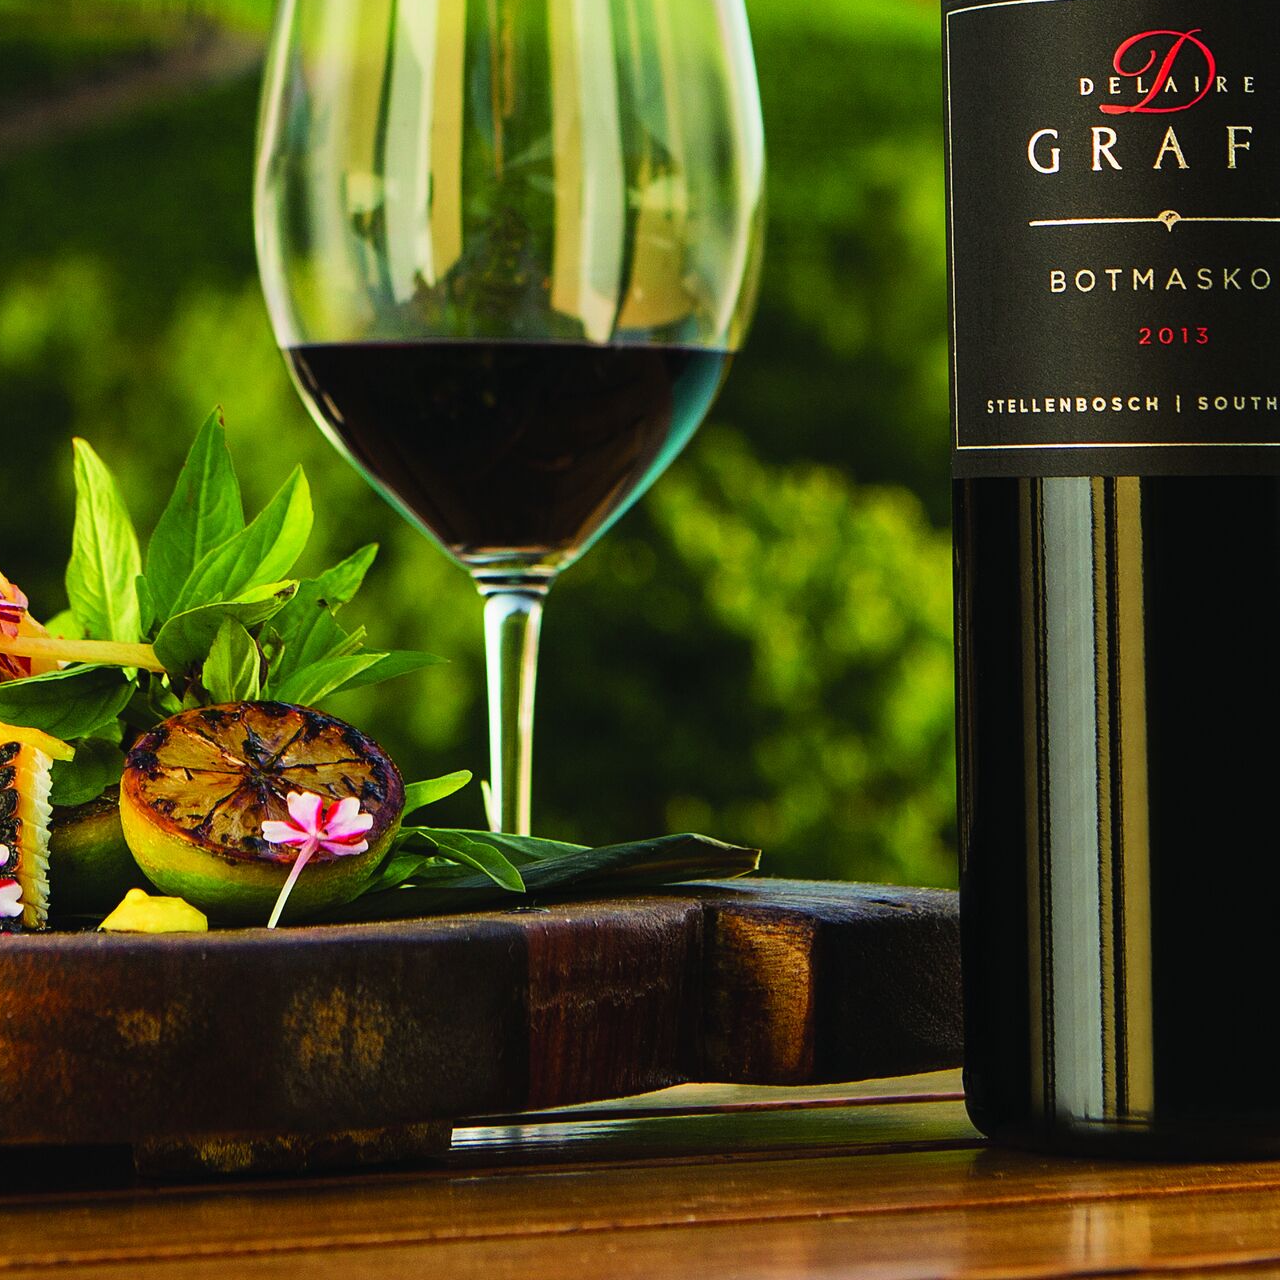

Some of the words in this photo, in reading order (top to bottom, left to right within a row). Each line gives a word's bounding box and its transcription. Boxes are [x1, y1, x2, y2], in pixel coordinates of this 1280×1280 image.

[1080, 75, 1255, 96] DELAIRE
[1138, 327, 1210, 345] 2013
[987, 396, 1159, 414] STELLENBOSCH
[1198, 396, 1278, 412] SOUTH
